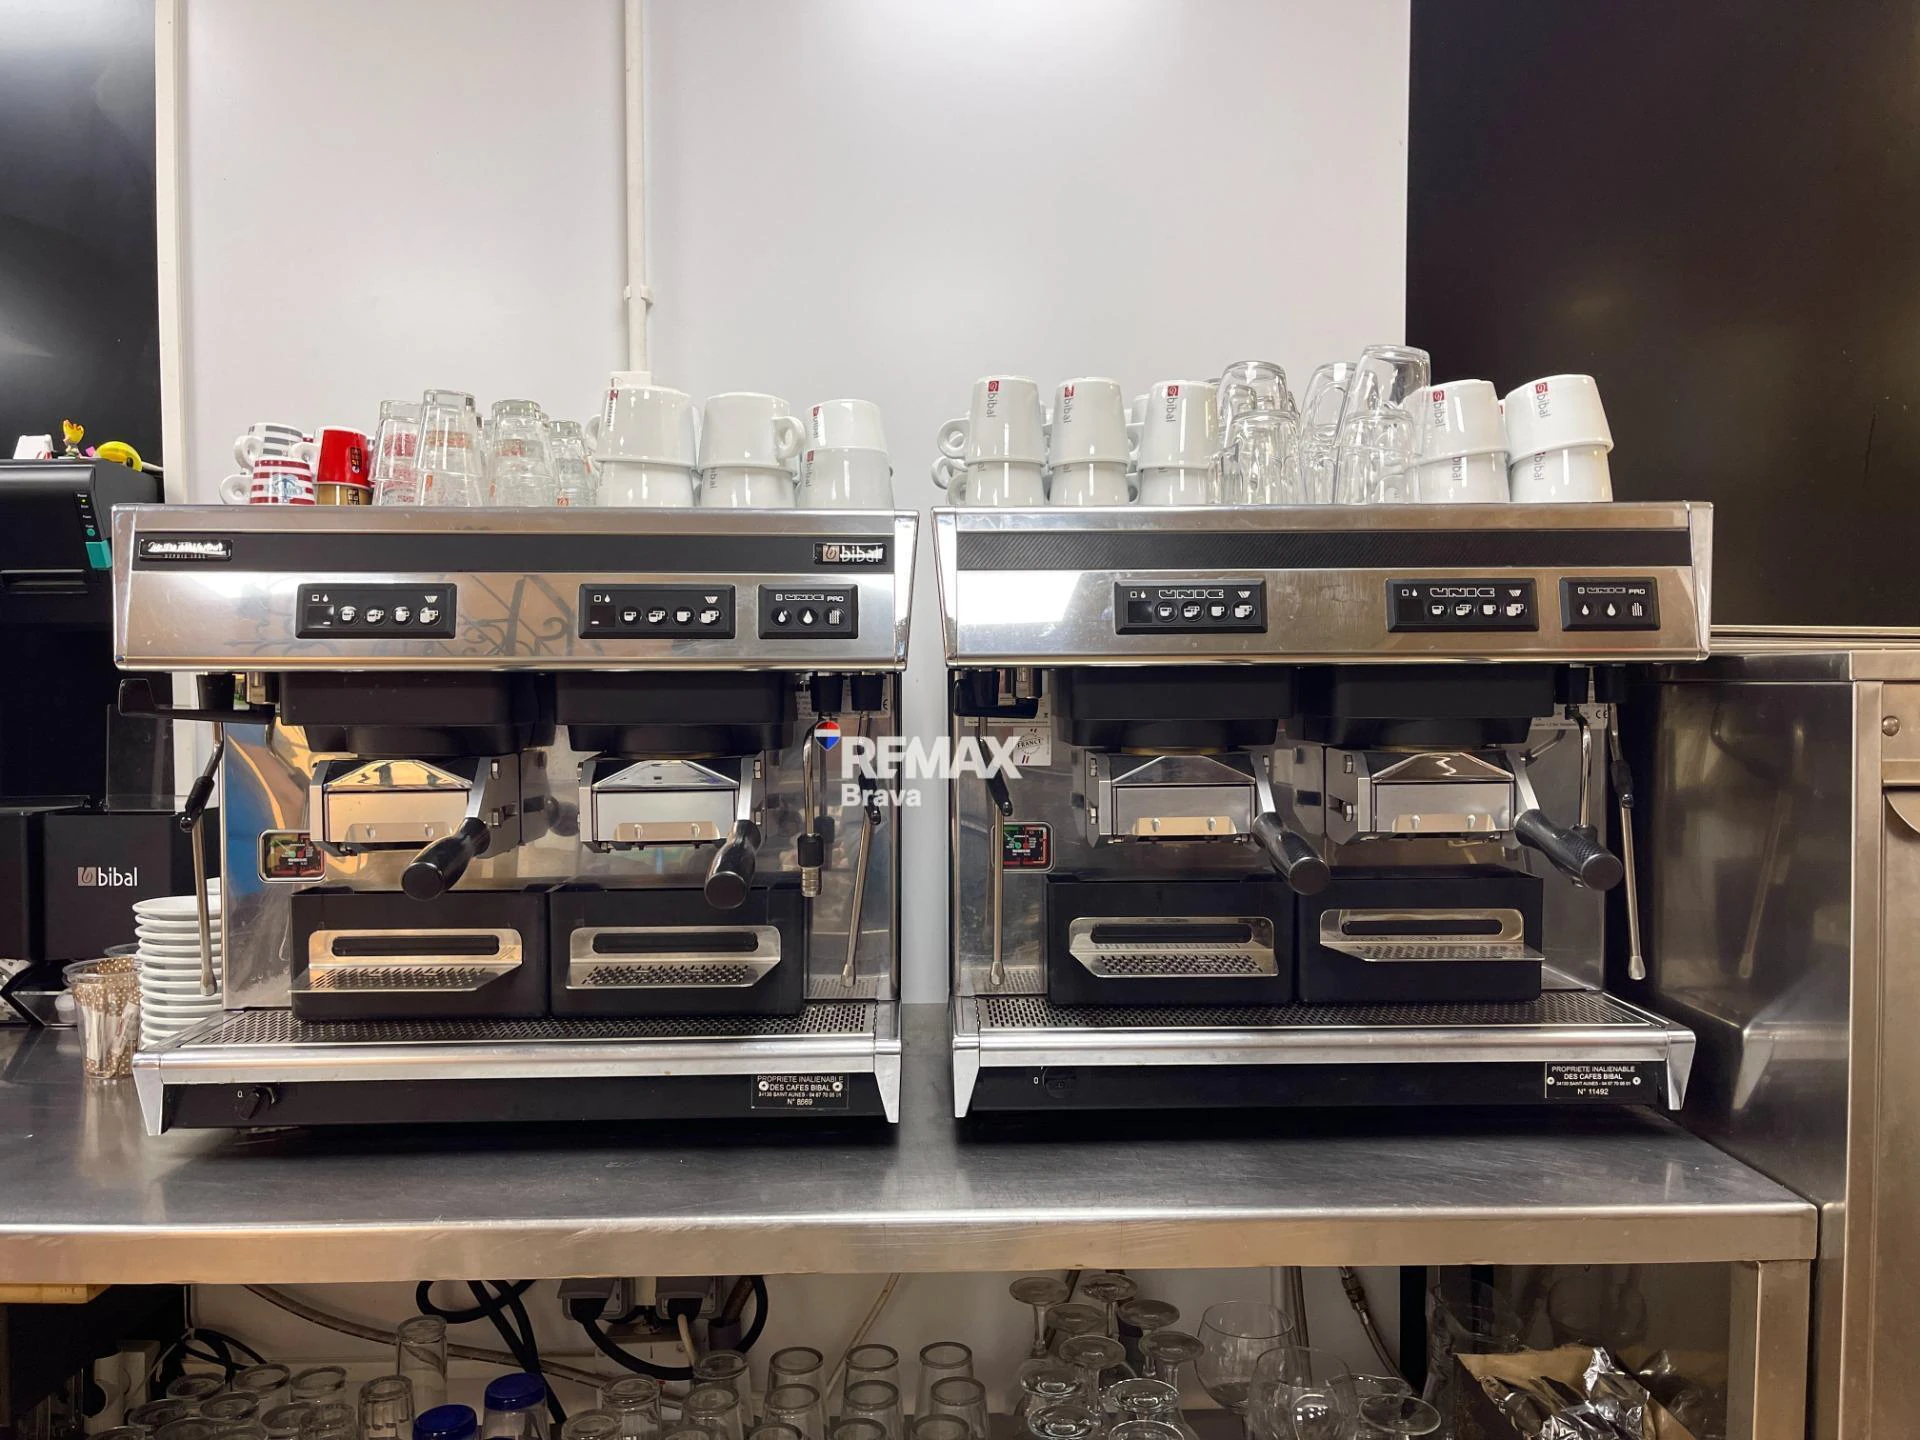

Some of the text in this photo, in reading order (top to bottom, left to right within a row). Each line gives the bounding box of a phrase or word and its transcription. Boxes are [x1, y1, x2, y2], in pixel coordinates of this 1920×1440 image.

[986, 392, 998, 418] bibal
[1063, 397, 1073, 424] bibal
[1165, 397, 1179, 423] bibal
[1433, 401, 1446, 428] bibal
[1537, 393, 1551, 418] bibal
[1534, 455, 1545, 481] bibal
[839, 544, 884, 562] bibal
[97, 866, 138, 887] bibal
[757, 1075, 844, 1083] PROPRIETE INALIENABLE
[785, 1084, 809, 1092] CAFES
[810, 1084, 831, 1092] BIBAL
